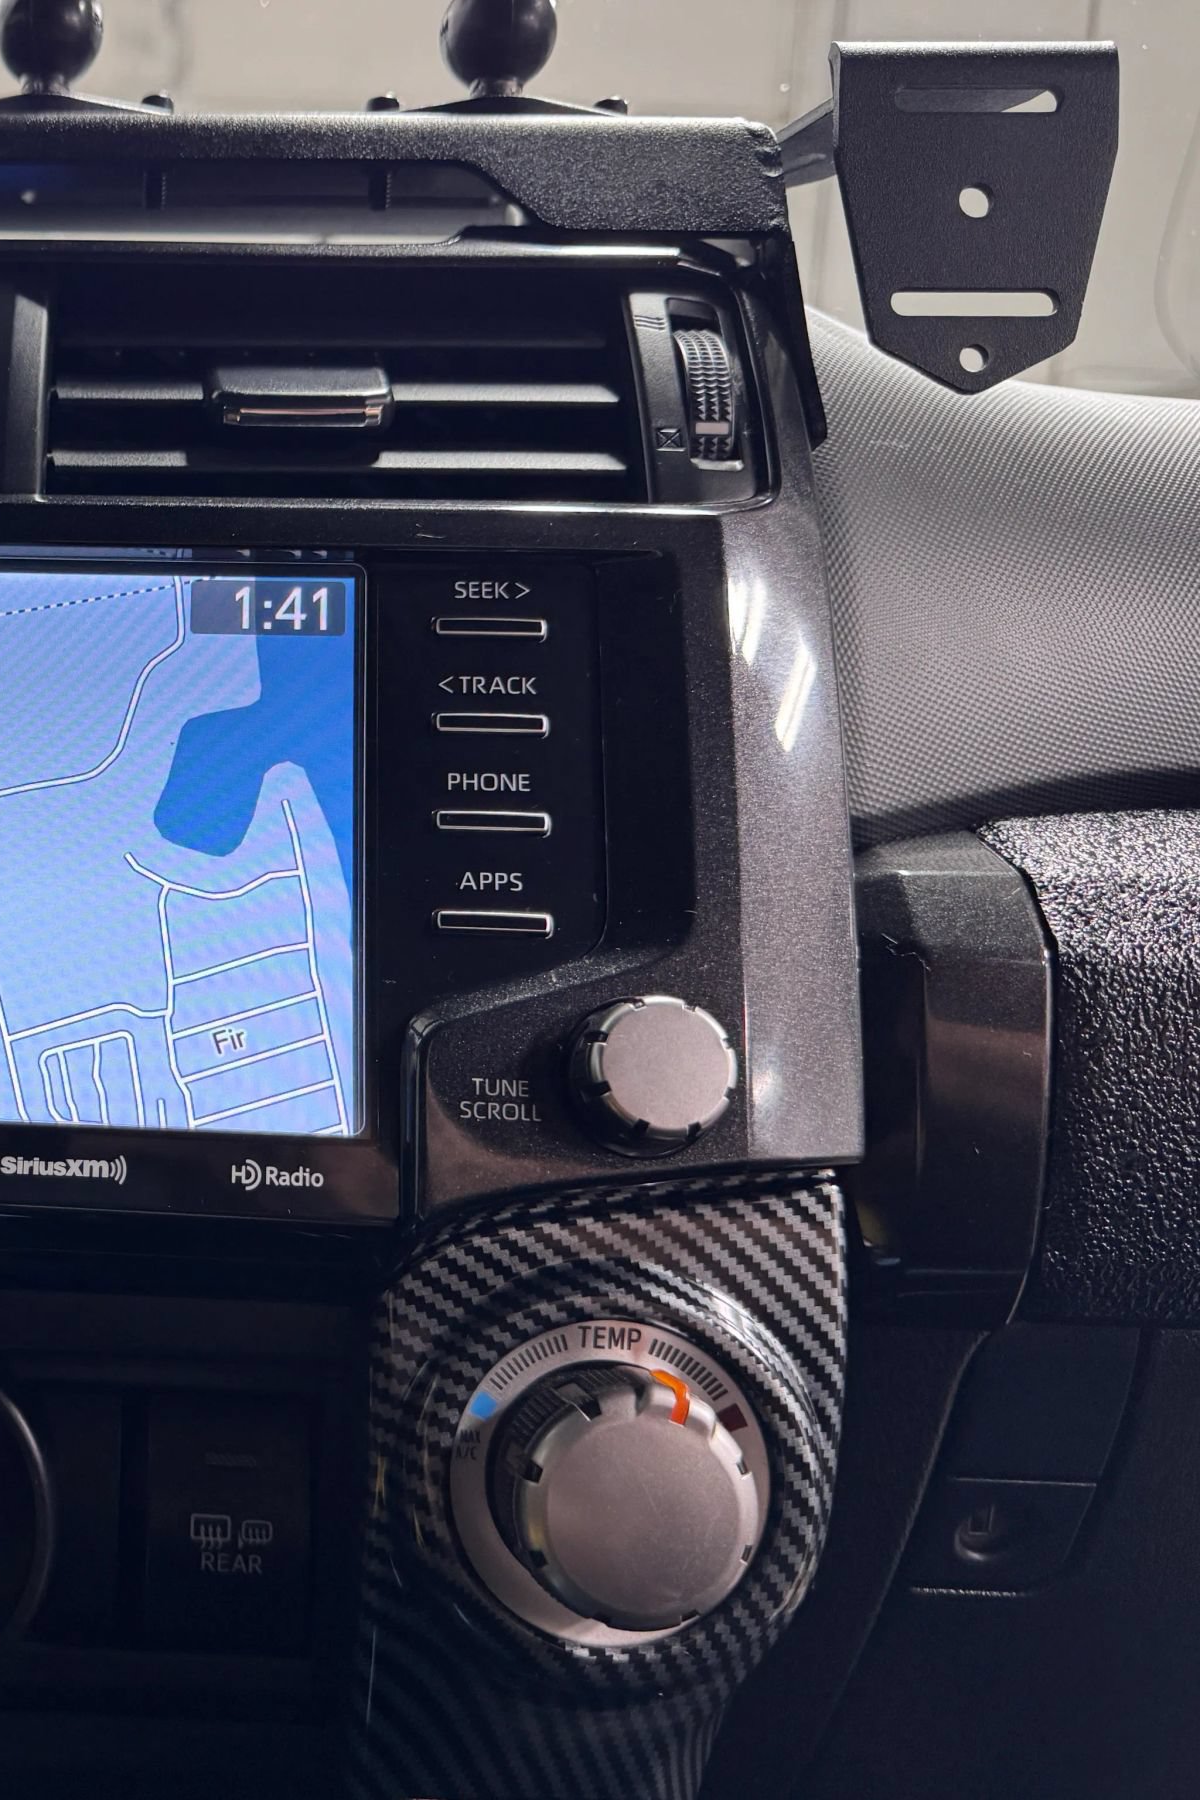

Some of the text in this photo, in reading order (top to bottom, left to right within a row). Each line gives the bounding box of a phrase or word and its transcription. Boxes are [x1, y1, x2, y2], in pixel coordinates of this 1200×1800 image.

[235, 586, 329, 631] 1:41
[447, 773, 531, 792] PHONE
[459, 871, 523, 891] APPS
[211, 1028, 246, 1054] Fir
[472, 1077, 529, 1097] TUNE
[460, 1101, 542, 1121] SCROLL
[265, 1165, 324, 1188] Radio
[577, 1325, 643, 1351] TEMP
[201, 1551, 263, 1574] REAR
